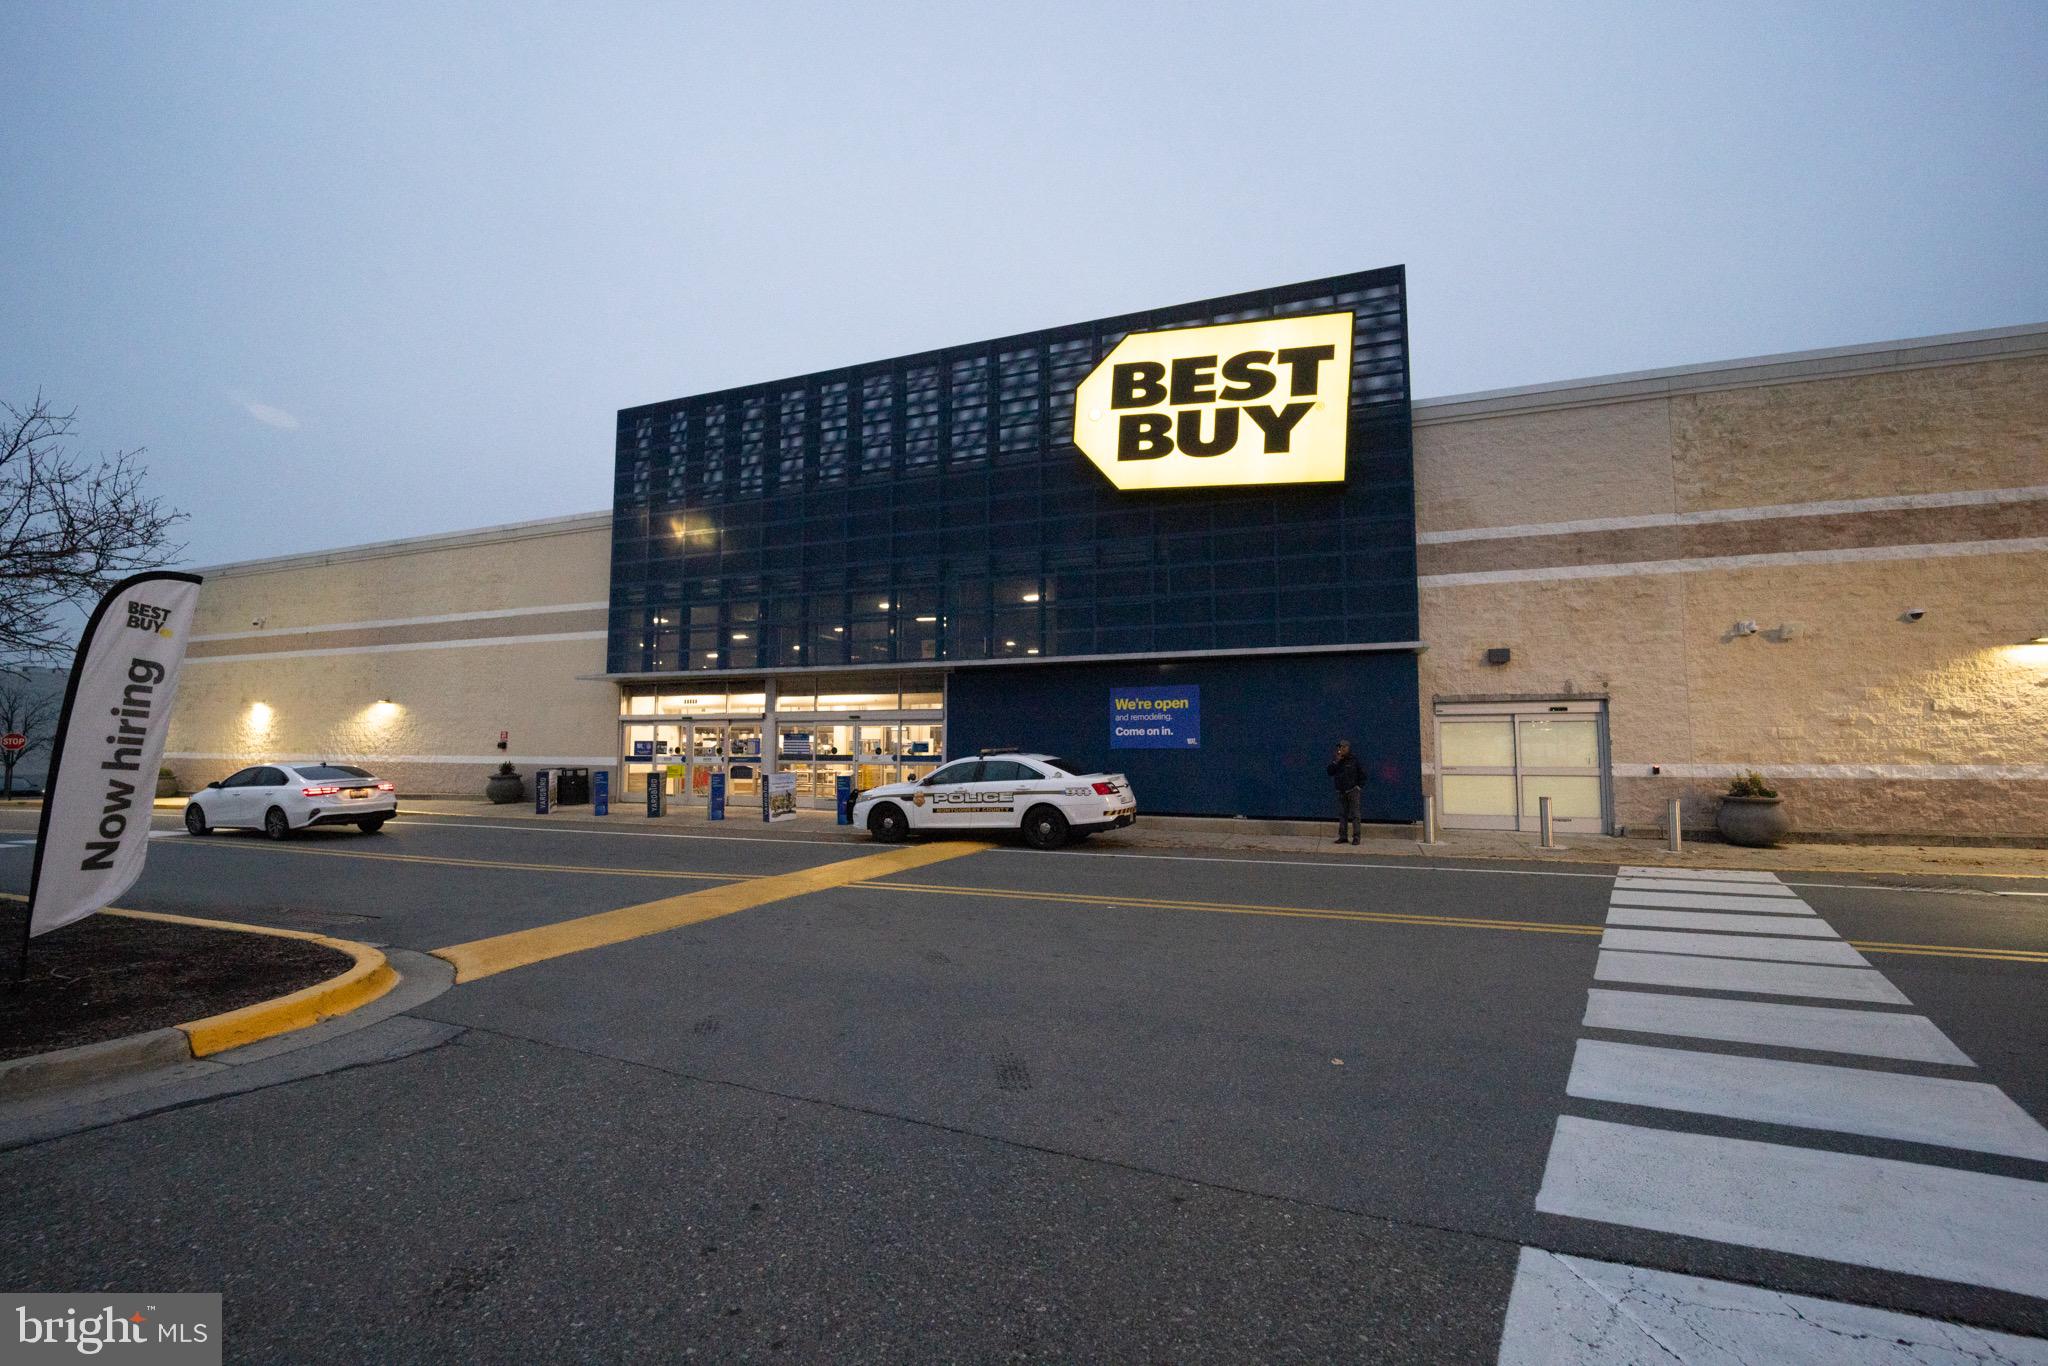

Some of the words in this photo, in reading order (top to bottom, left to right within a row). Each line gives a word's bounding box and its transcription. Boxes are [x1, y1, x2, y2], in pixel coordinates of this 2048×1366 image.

[1111, 344, 1335, 410] BEST
[1117, 401, 1317, 461] BUY
[128, 601, 171, 622] BEST
[126, 615, 164, 634] BUY
[101, 658, 165, 771] hiring
[1115, 698, 1152, 710] We're
[1154, 699, 1189, 712] open
[1115, 713, 1129, 721] and
[1130, 713, 1173, 722] remodeling.
[1115, 727, 1145, 736] Come
[1161, 726, 1174, 735] in.
[2, 737, 25, 746] STOP
[933, 792, 1014, 803] POLICE
[81, 779, 136, 871] Now
